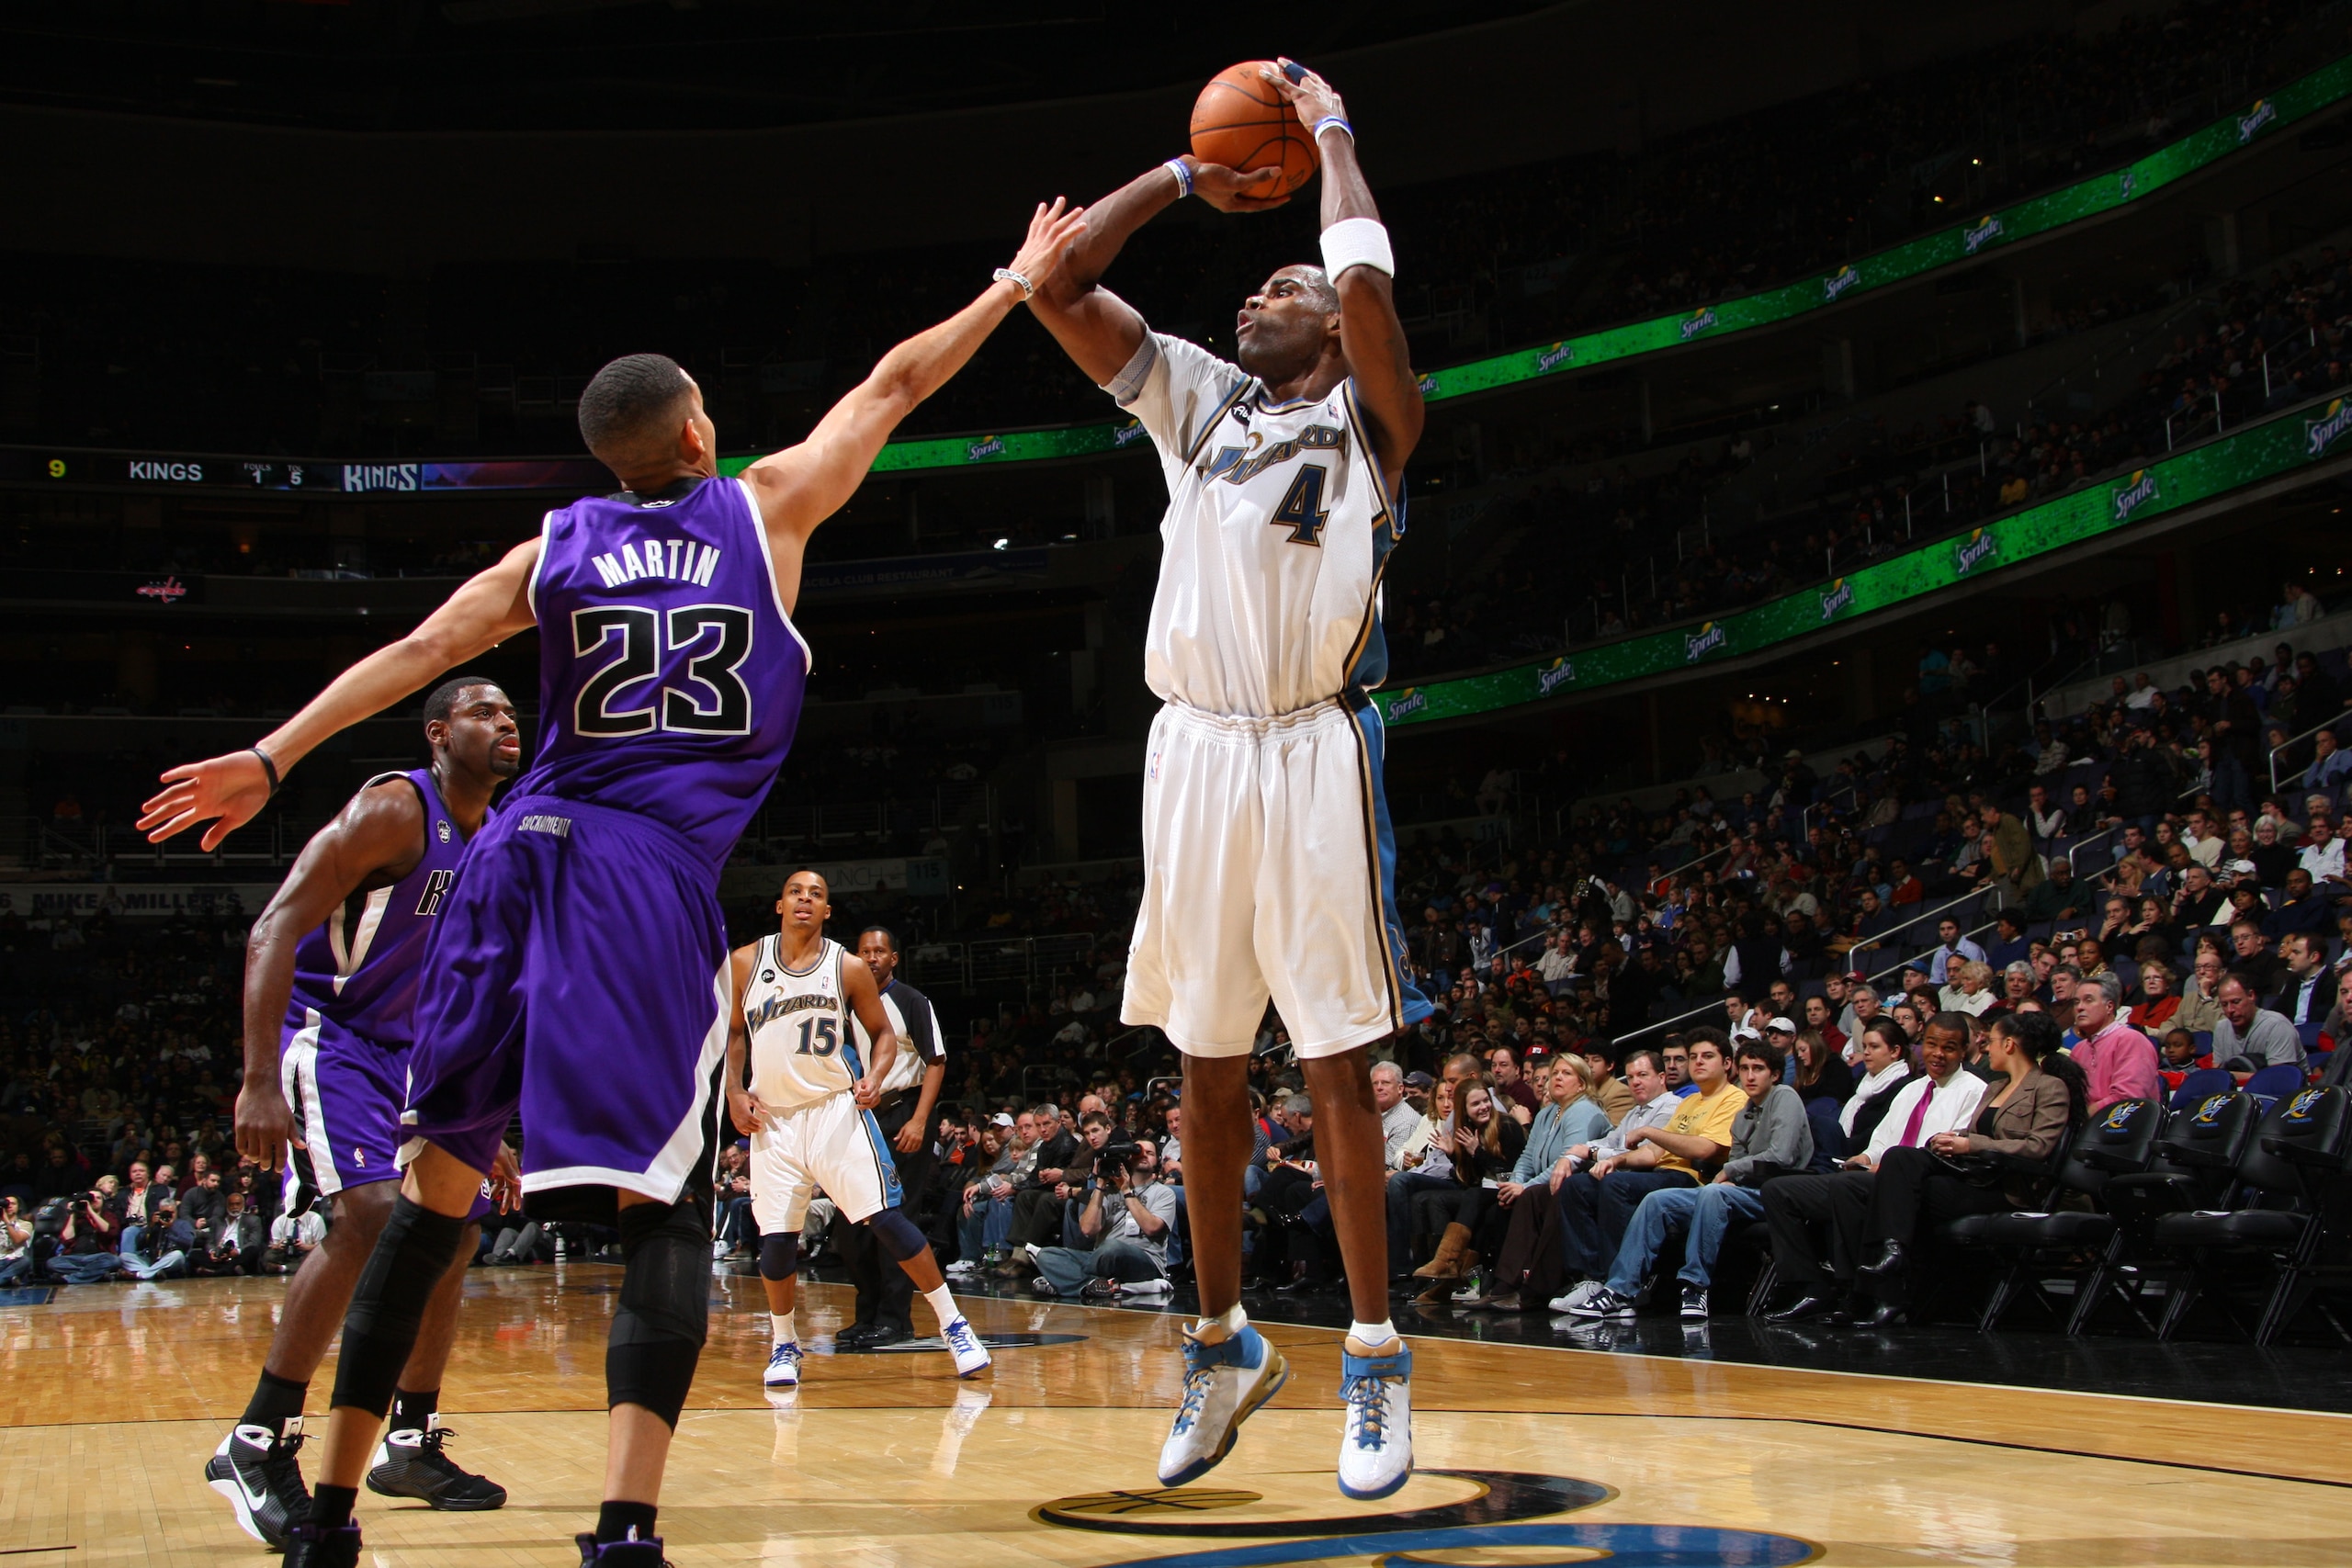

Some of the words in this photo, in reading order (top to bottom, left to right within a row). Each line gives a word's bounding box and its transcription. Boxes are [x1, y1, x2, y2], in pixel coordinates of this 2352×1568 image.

[1965, 218, 1999, 251] Sprite
[1826, 267, 1857, 299] Sprite
[1680, 310, 1714, 339] Sprite
[1539, 344, 1571, 371] Sprite
[968, 439, 1003, 459] Sprite
[48, 459, 67, 479] 9
[130, 460, 203, 482] KINGS
[243, 462, 272, 472] FOULS
[252, 470, 262, 484] 1
[287, 464, 304, 473] TOL
[290, 471, 302, 485] 5
[343, 463, 418, 492] KINGS
[1270, 463, 1330, 547] 4
[2115, 476, 2154, 520] Sprite
[591, 539, 721, 589] MARTIN
[1958, 534, 1992, 574] Sprite
[879, 568, 955, 583] RESTAURANT
[1822, 584, 1850, 619] Sprite
[1687, 627, 1723, 661] Sprite
[571, 604, 754, 738] 23
[1538, 662, 1572, 694] Sprite
[1387, 694, 1424, 721] Sprite
[914, 862, 940, 879] 115
[33, 893, 98, 909] MIKE
[125, 893, 242, 910] MILLER'S
[746, 993, 839, 1038] WIZARDS
[795, 1016, 837, 1057] 15
